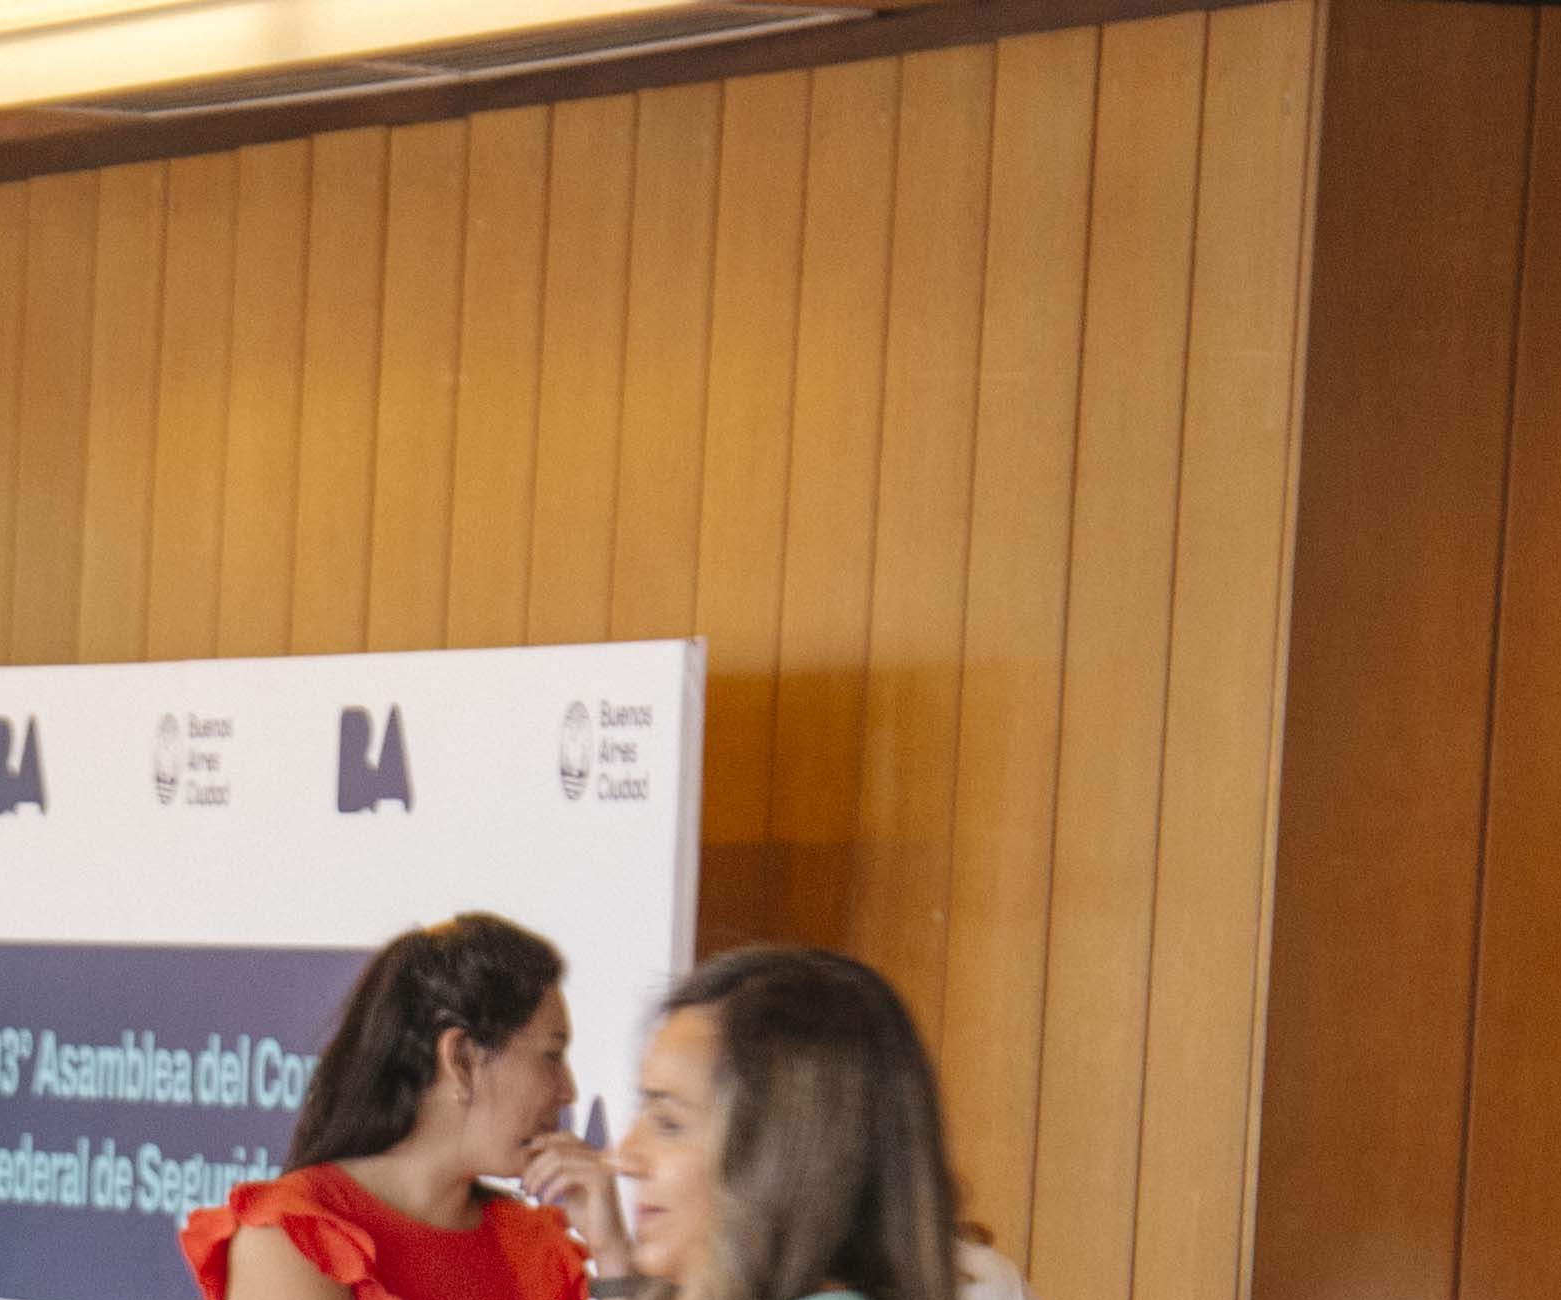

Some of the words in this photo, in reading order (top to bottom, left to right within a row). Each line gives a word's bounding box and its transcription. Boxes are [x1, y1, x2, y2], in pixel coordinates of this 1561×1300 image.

[33, 1028, 193, 1104] Asamblea
[194, 1032, 252, 1108] del
[91, 1137, 133, 1211] de
